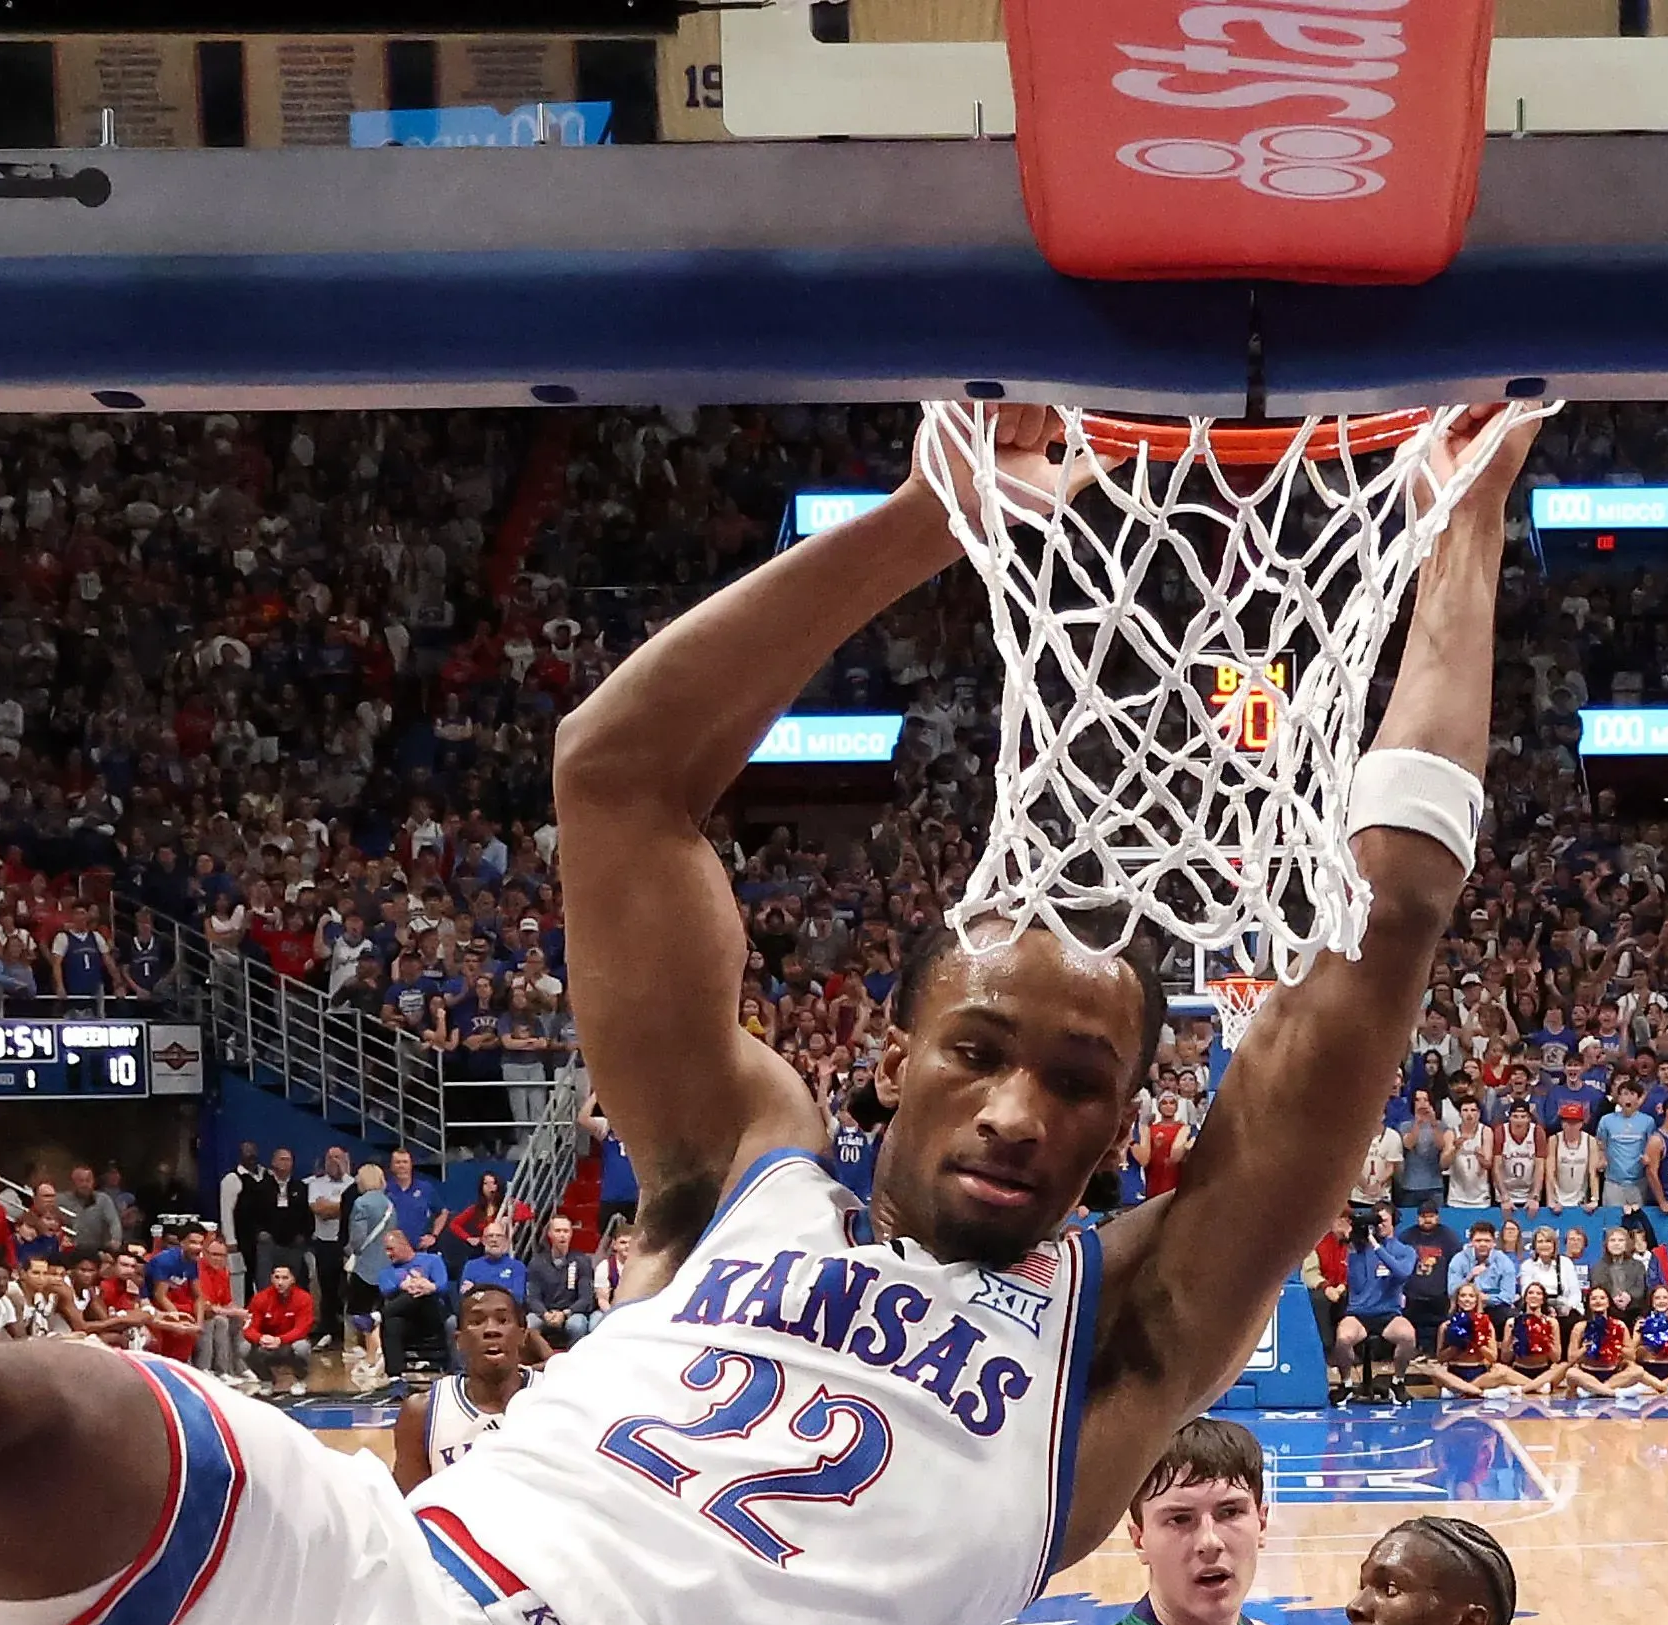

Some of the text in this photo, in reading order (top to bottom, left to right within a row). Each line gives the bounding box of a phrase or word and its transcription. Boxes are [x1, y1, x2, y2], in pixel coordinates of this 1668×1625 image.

[1596, 502, 1665, 521] MIDCO
[807, 732, 886, 756] MIDCO
[109, 1055, 137, 1086] 10
[673, 1250, 1032, 1437] KANSAS
[595, 1347, 894, 1569] 22
